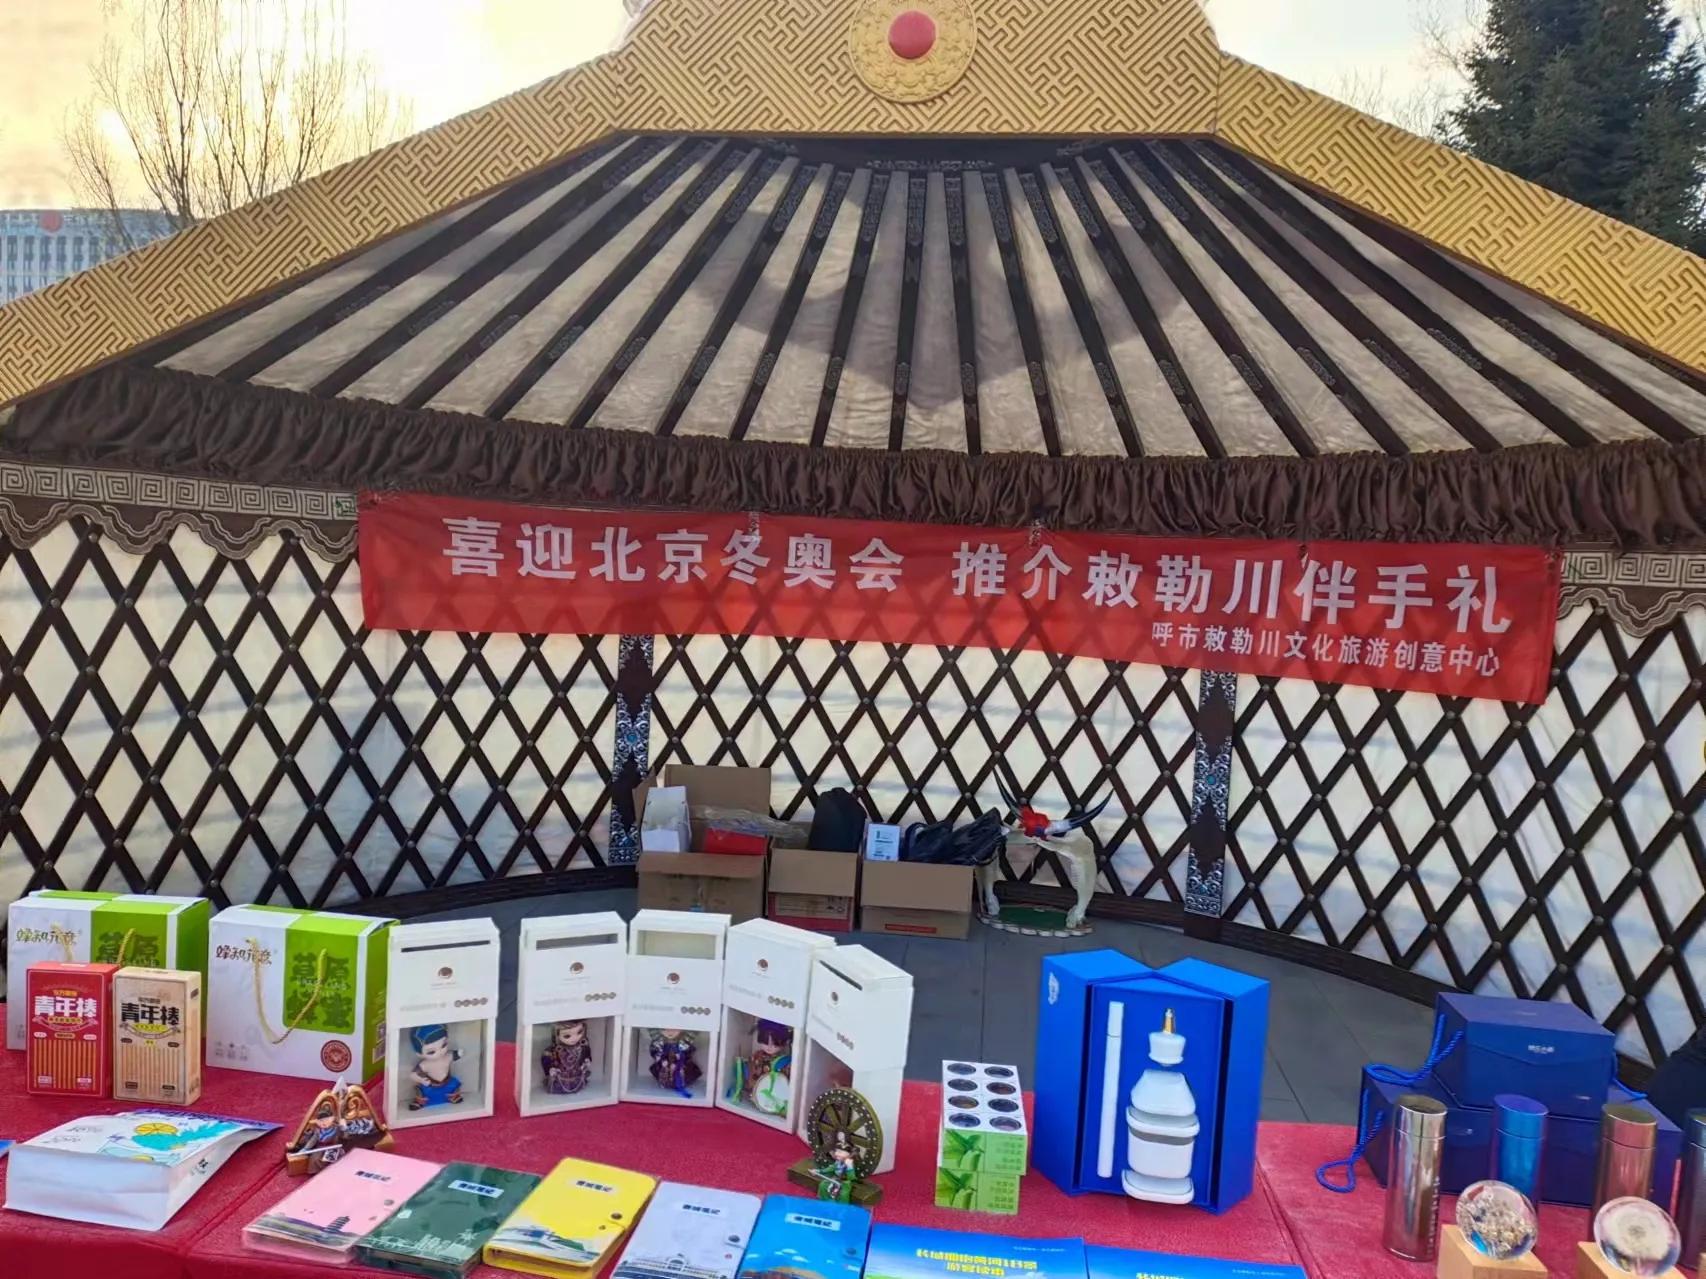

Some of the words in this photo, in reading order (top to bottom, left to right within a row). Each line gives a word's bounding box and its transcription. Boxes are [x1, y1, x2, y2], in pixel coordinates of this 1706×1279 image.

[442, 515, 905, 592] 喜迎北京冬奥会
[951, 541, 1512, 634] 推介敕勒川伴手礼
[1151, 622, 1501, 678] 呼市敕勒川文化旅游创意中心
[34, 995, 97, 1018] 青年棒
[121, 1002, 180, 1026] 青年棒
